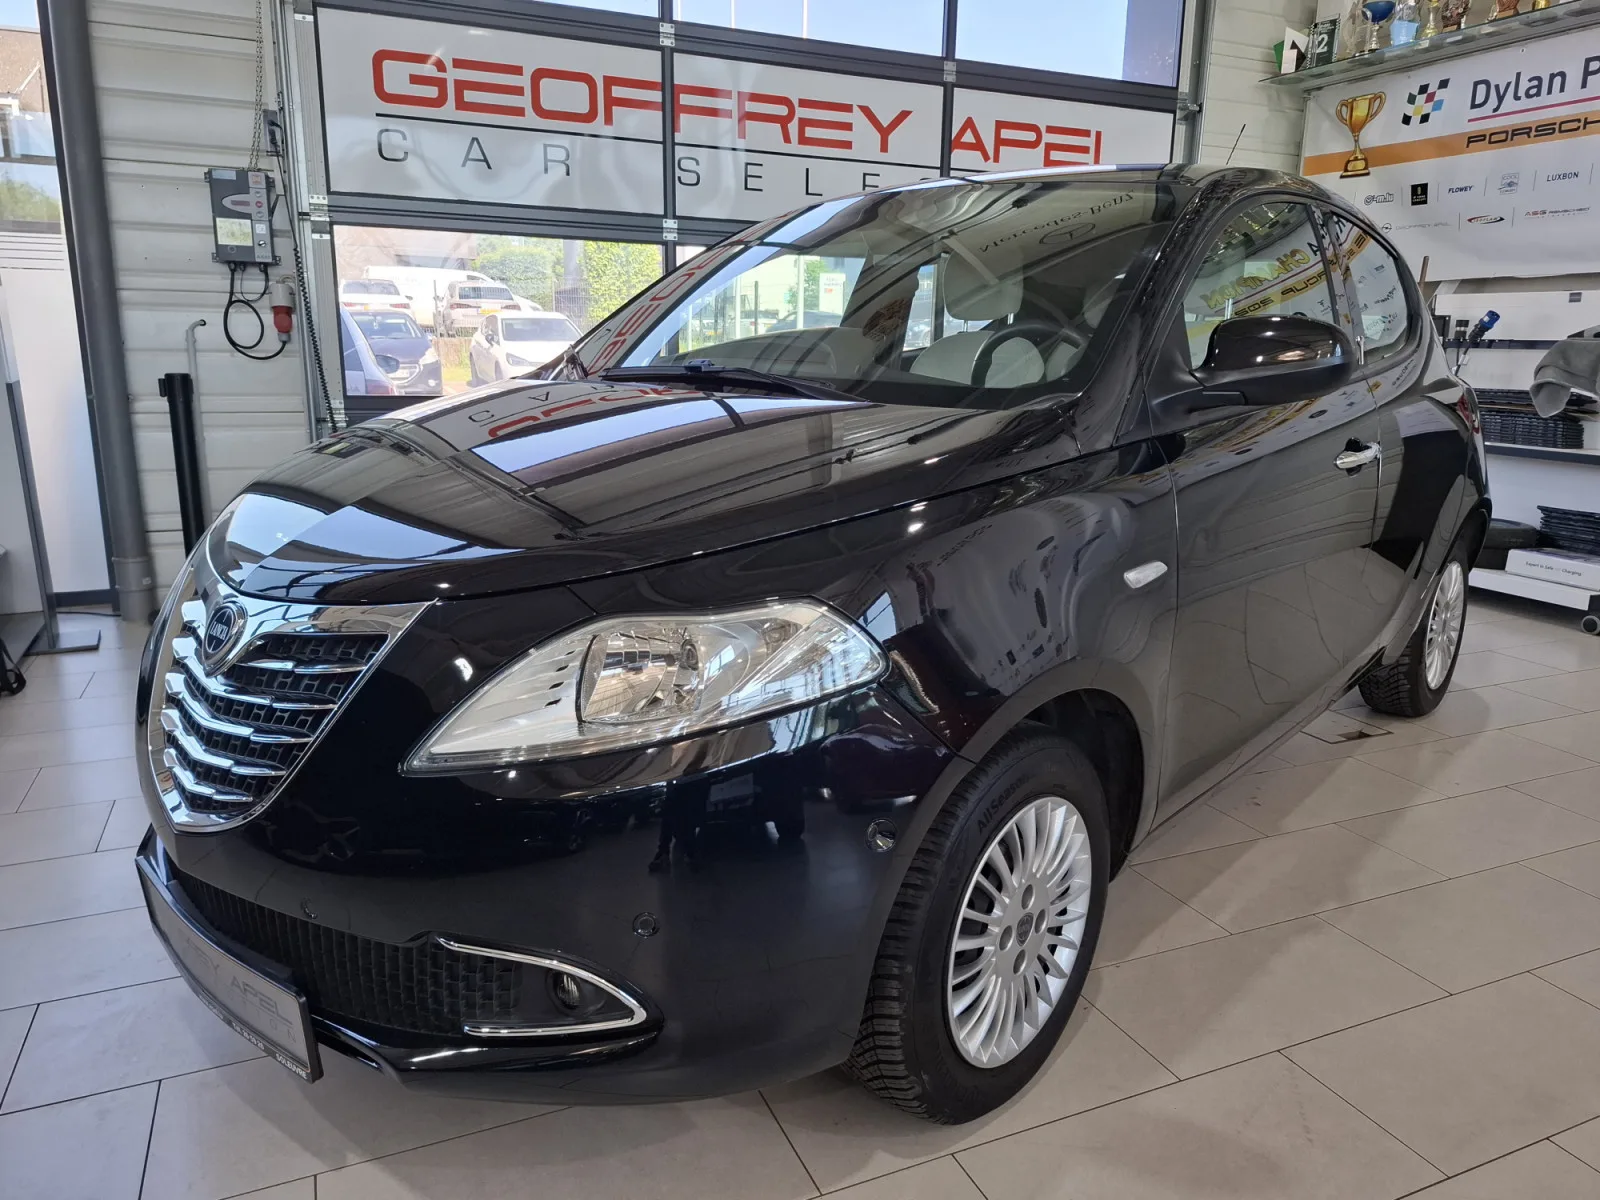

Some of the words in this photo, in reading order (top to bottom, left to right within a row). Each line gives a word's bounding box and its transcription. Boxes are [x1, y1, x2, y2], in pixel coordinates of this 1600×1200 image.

[372, 48, 913, 153] GEOFFREY
[1470, 71, 1567, 113] Dylan
[677, 156, 934, 197] SELE
[1447, 185, 1474, 194] FLOWEY
[1546, 171, 1580, 182] LUXBON
